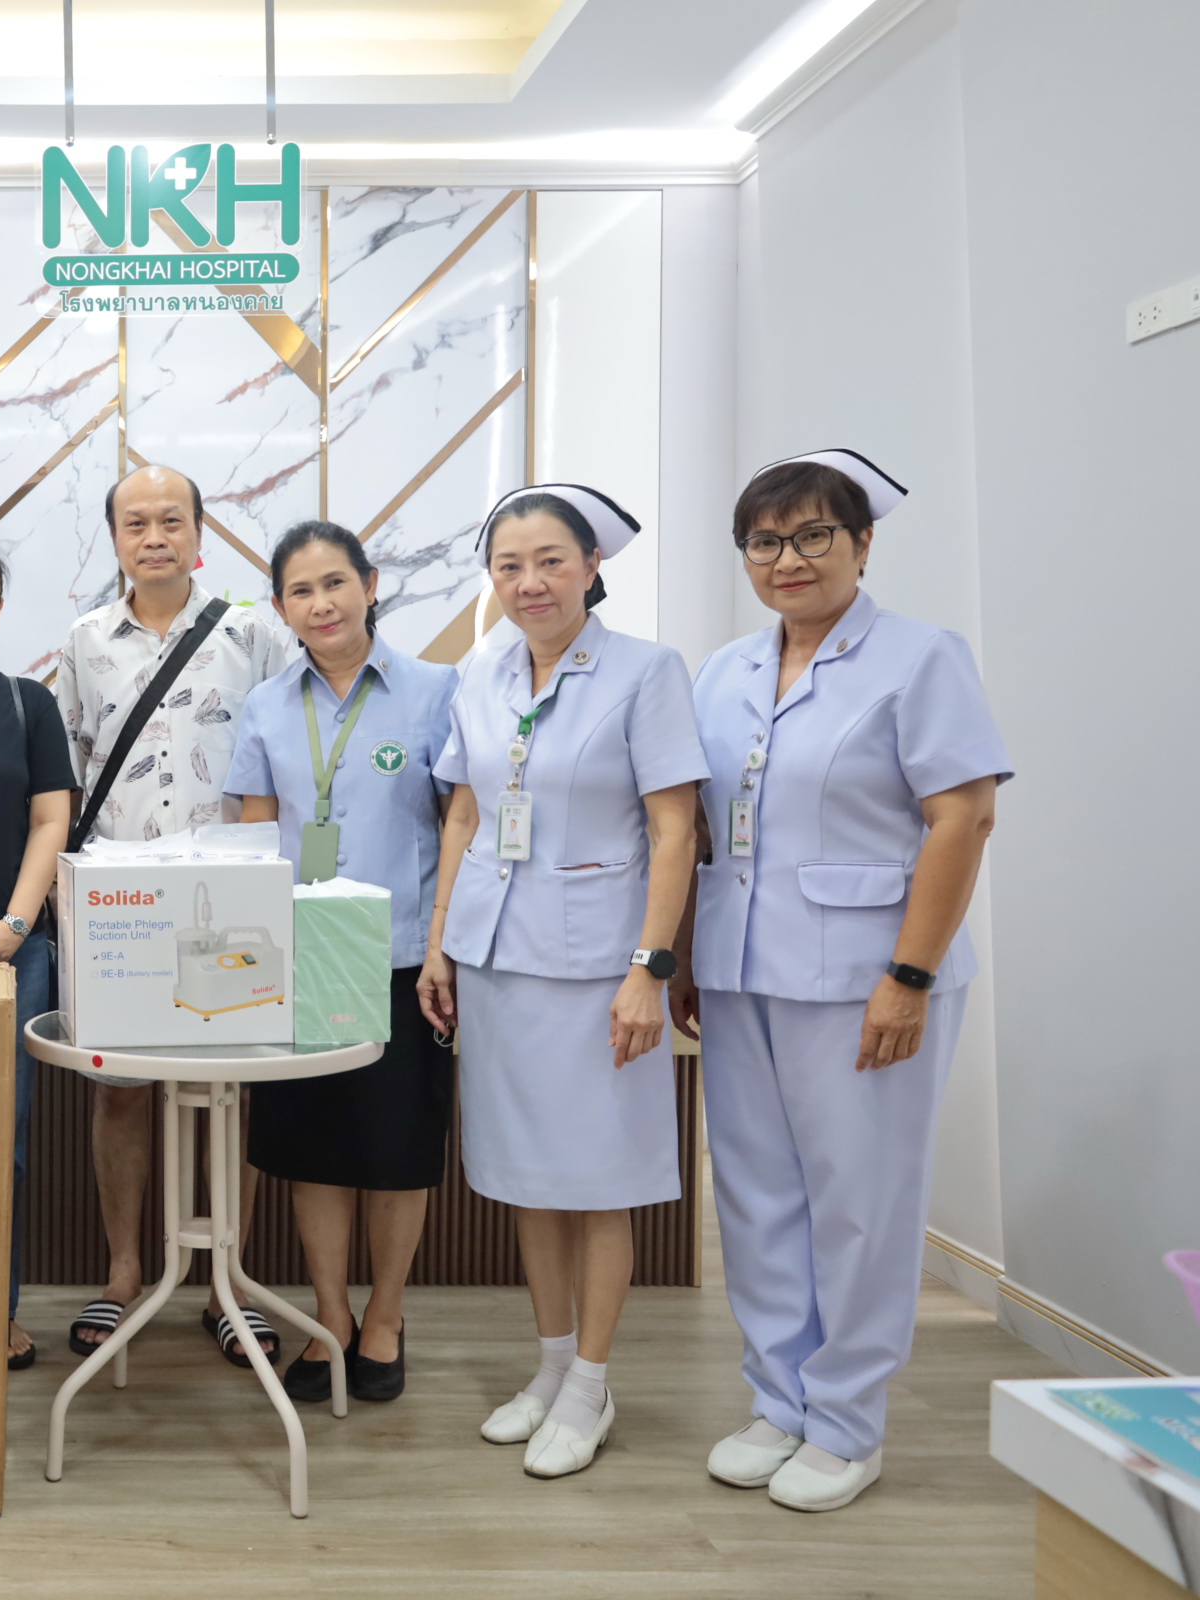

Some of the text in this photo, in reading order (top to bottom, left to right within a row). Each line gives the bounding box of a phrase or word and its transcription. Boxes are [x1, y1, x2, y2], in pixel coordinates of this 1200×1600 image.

[42, 142, 300, 249] NKH
[55, 259, 286, 281] NONGKHAI HOSPITAL
[59, 290, 284, 312] โรงพยาบาลหนองคาย
[88, 919, 174, 931] Portable Phlegm
[88, 930, 151, 941] Suction Unit
[100, 951, 125, 961] 9E-A
[100, 969, 124, 978] 9E-B
